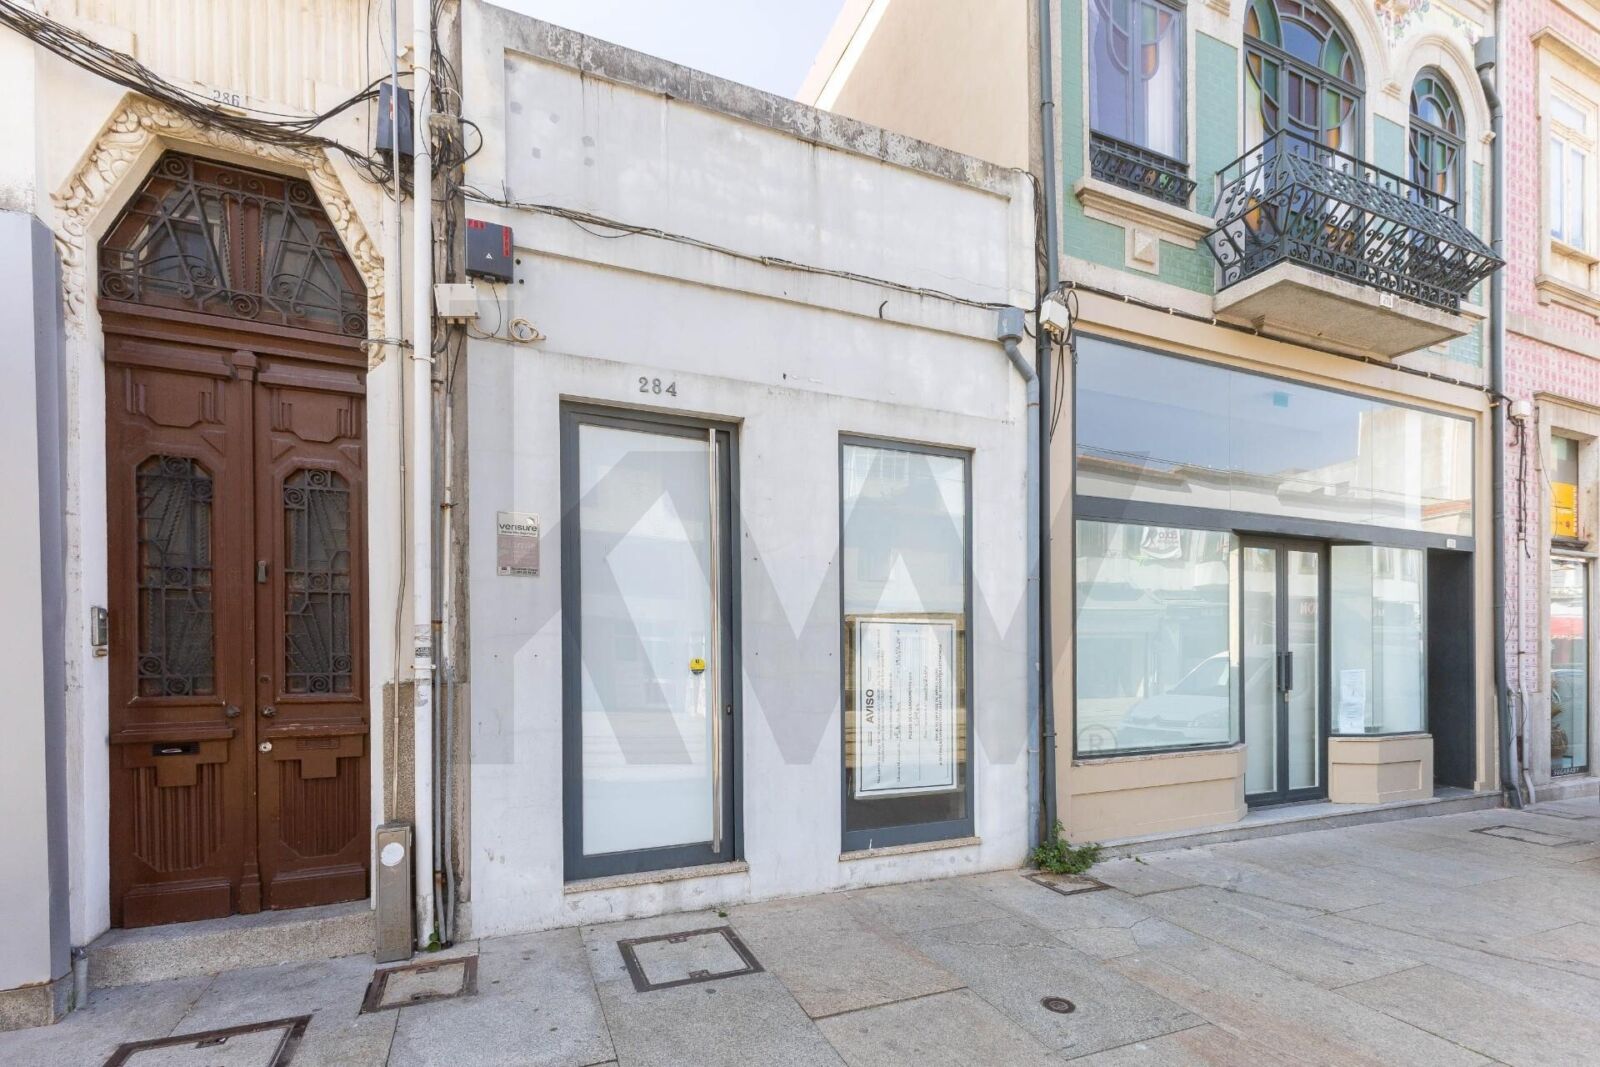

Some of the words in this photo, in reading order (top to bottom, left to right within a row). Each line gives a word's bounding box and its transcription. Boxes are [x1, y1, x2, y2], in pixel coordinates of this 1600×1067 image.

[213, 89, 241, 107] 286
[638, 376, 678, 397] 284
[499, 523, 539, 532] verisure
[864, 688, 875, 724] AVISO
